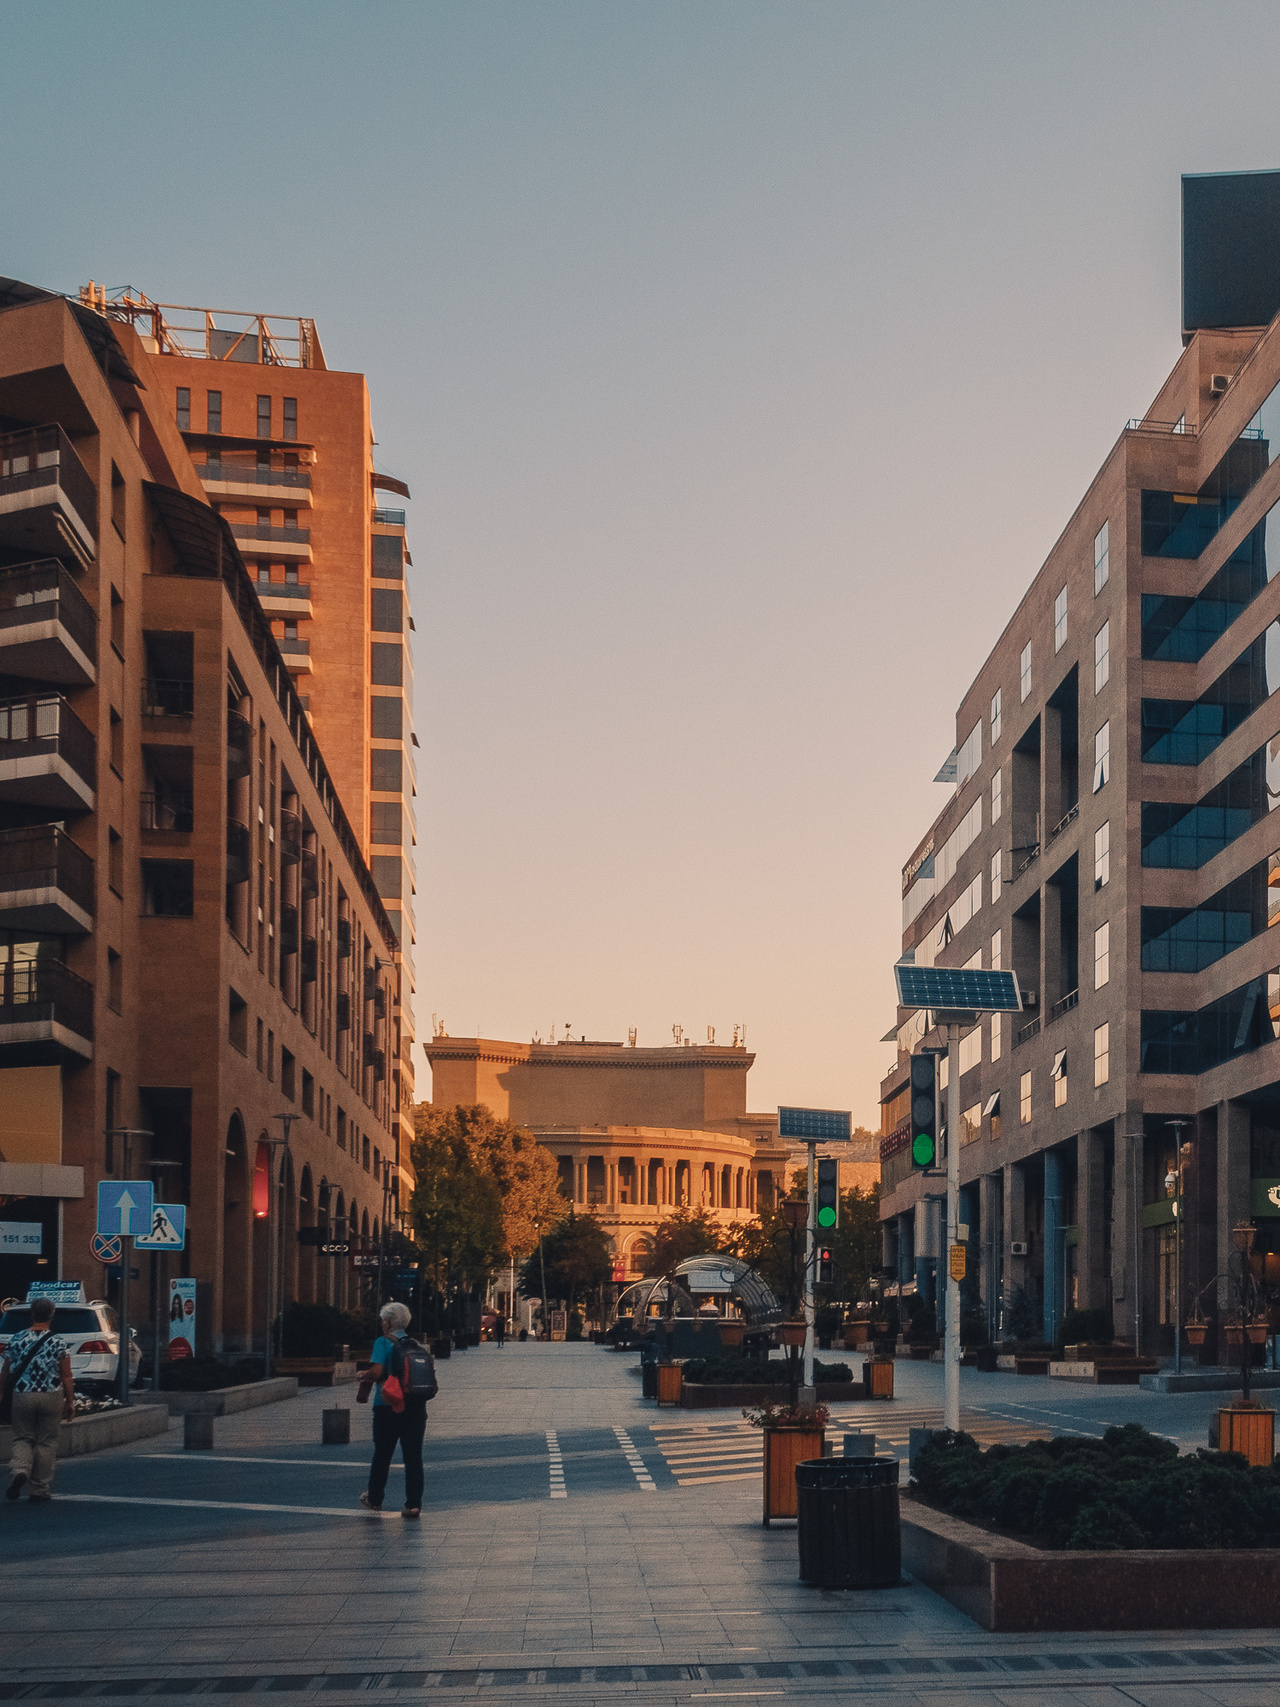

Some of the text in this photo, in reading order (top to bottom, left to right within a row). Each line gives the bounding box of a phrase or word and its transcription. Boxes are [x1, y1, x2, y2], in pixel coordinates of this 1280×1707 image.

[3, 1234, 41, 1244] 151 353
[322, 1244, 349, 1252] ecco
[31, 1280, 80, 1291] goodcar
